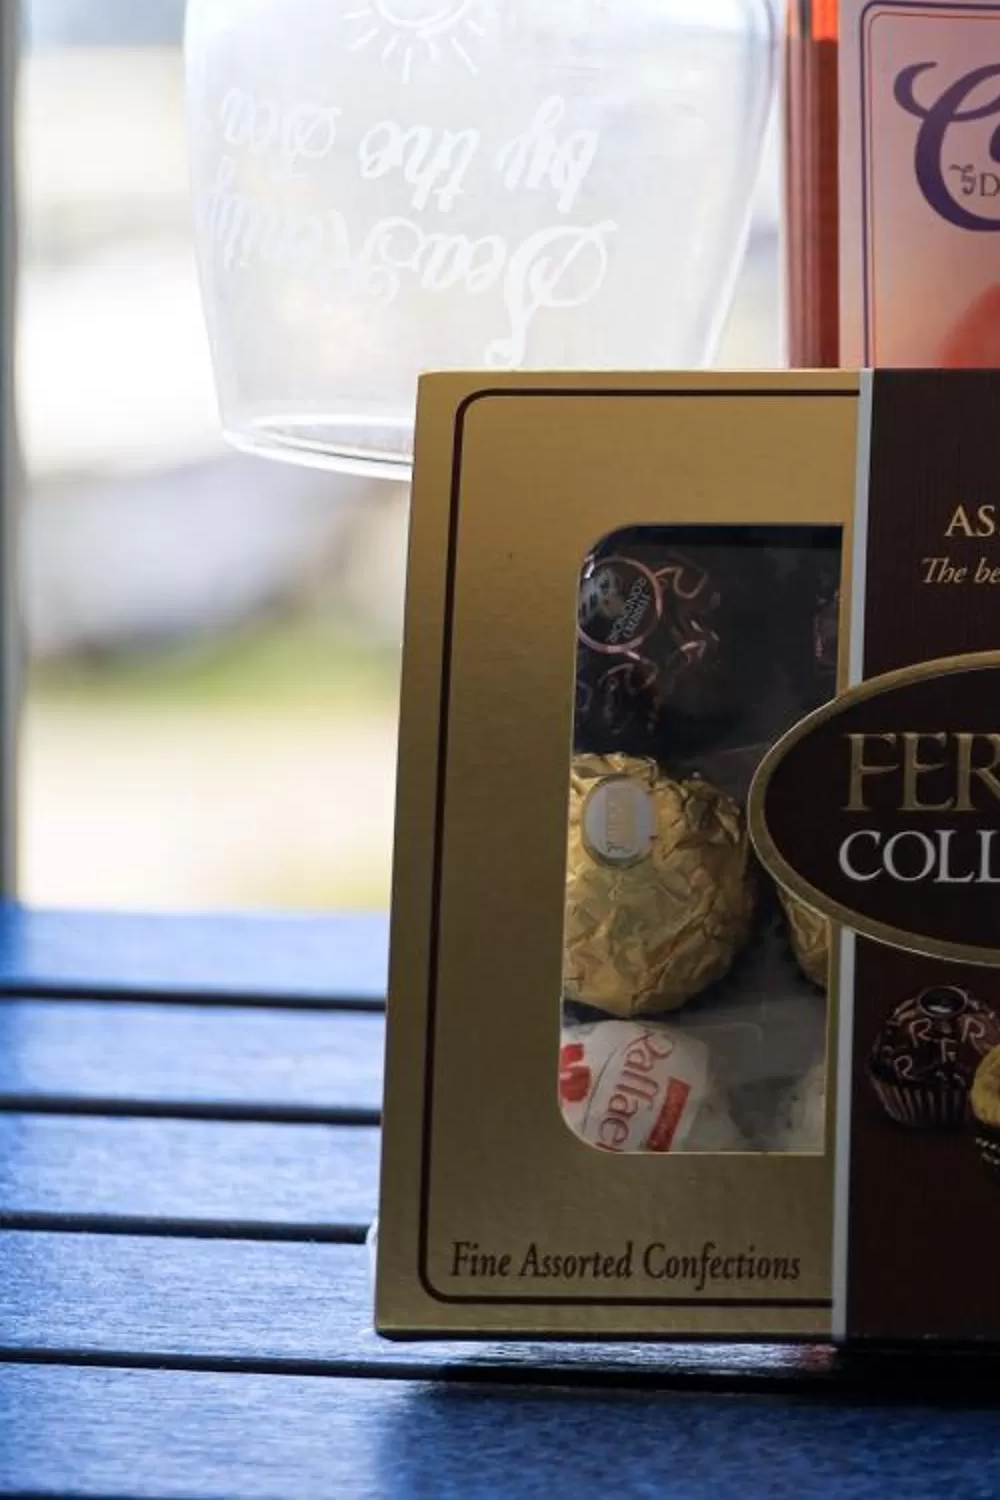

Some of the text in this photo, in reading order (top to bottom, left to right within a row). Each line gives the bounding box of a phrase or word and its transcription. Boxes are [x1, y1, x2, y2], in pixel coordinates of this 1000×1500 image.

[359, 121, 480, 212] the
[496, 95, 598, 212] by
[921, 557, 968, 584] The
[595, 1029, 674, 1152] Raffae
[450, 1240, 801, 1291] Fine Assorted Confections
